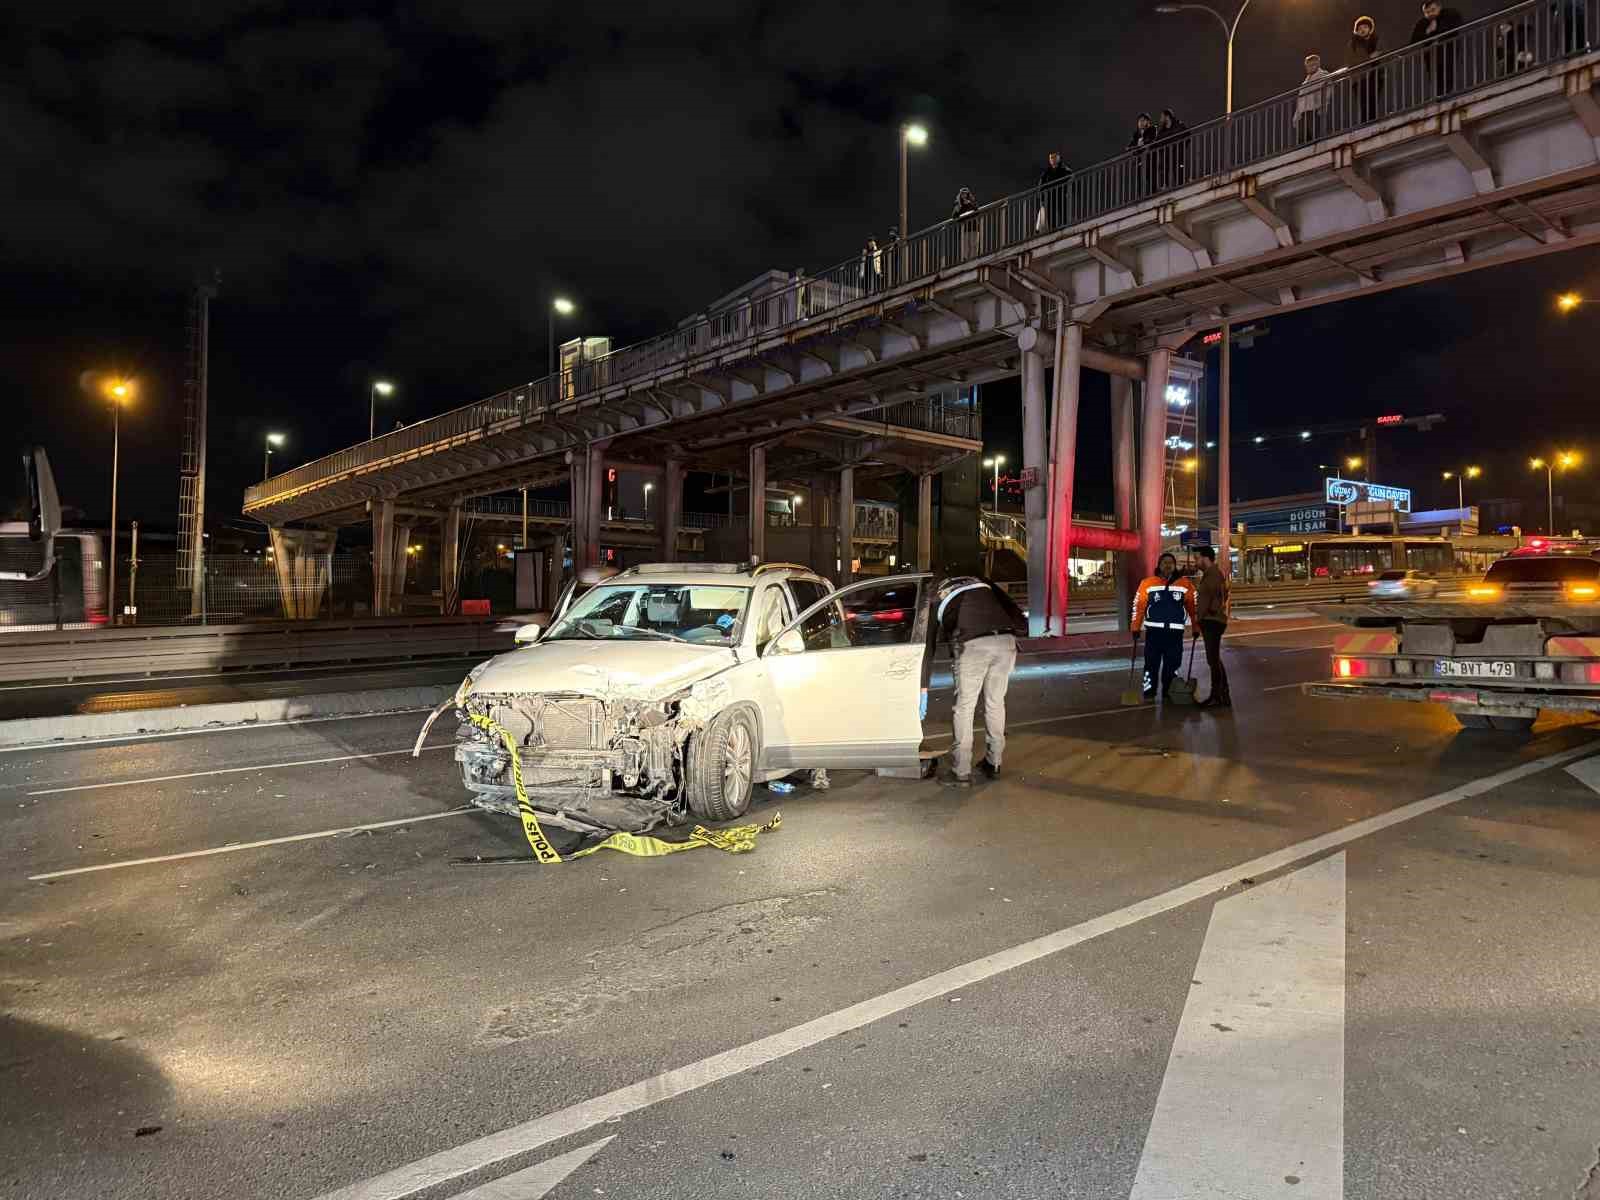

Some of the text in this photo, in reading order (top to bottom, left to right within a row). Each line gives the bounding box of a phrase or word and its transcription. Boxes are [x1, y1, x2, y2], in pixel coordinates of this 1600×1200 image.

[1441, 662, 1455, 674] 34
[1460, 663, 1482, 675] BVT
[1489, 663, 1512, 676] 479
